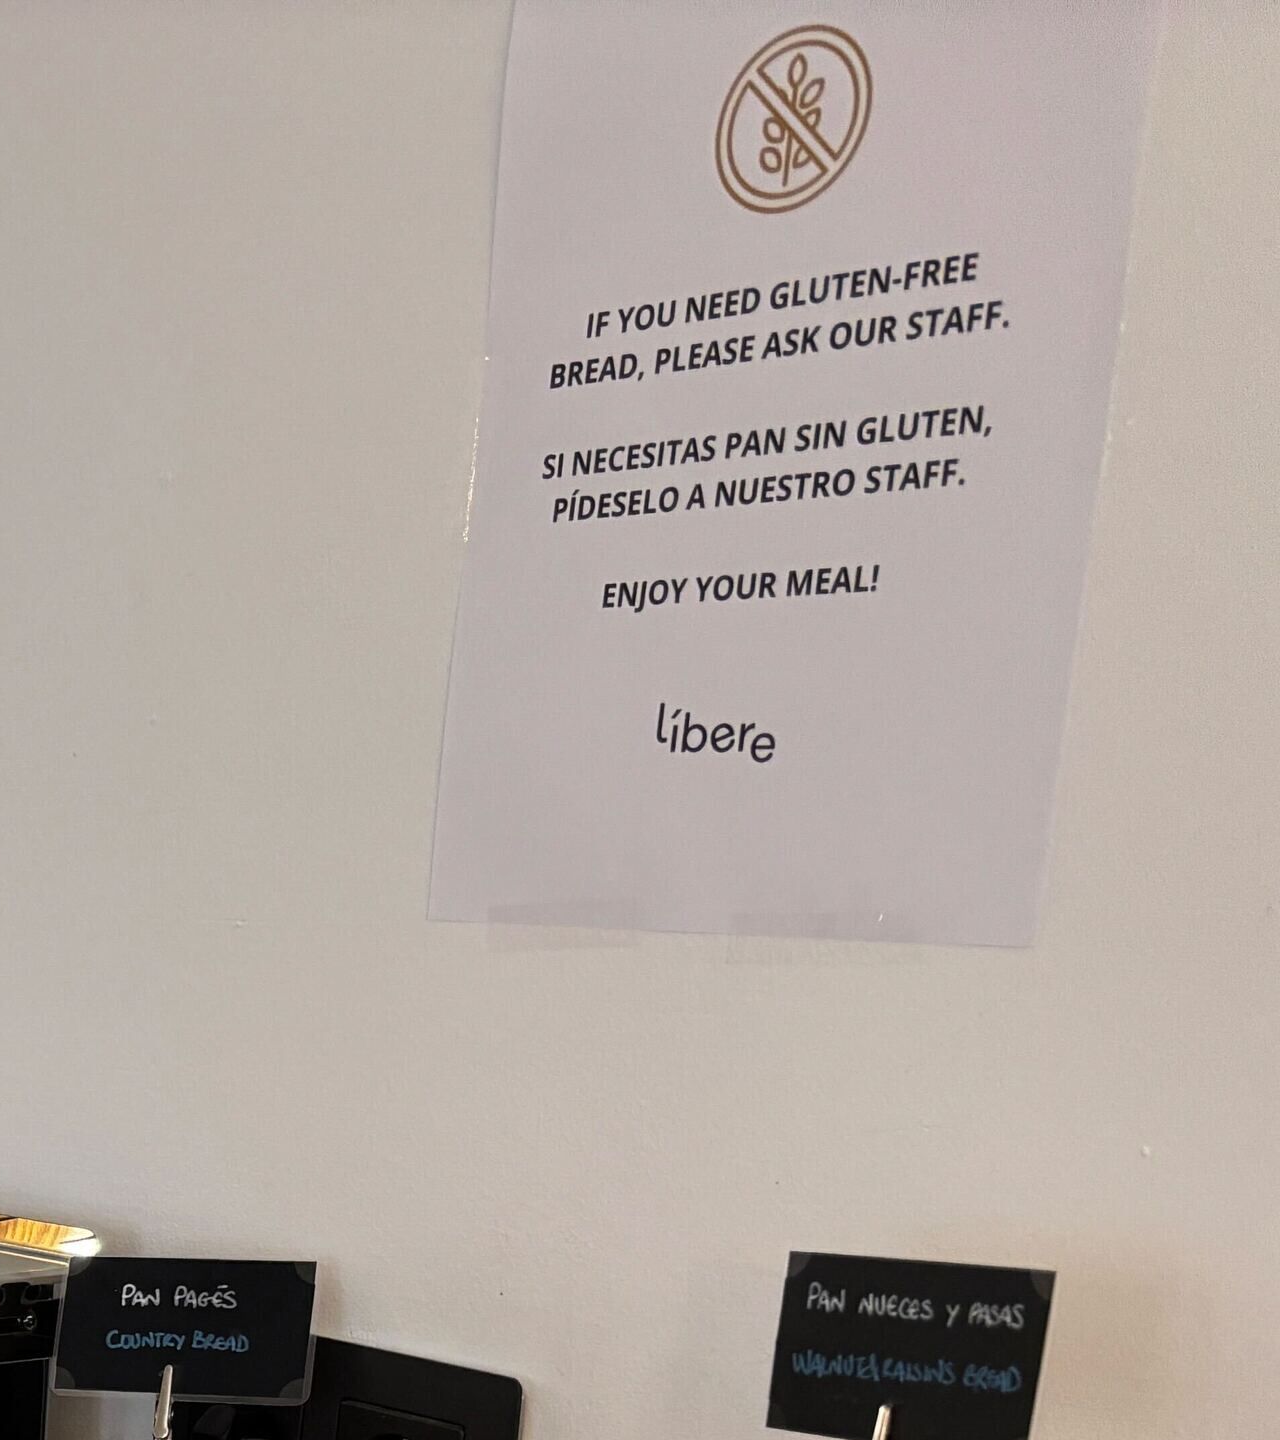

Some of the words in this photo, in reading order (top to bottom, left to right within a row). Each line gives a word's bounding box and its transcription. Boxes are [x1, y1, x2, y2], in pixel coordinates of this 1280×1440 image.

[586, 310, 611, 339] IF
[617, 299, 677, 334] YOU
[684, 287, 762, 324] NEED
[769, 252, 980, 311] GLUTEN-FREE
[549, 352, 645, 390] BREAD,
[654, 334, 756, 375] PLEASE
[760, 324, 822, 360] ASK
[829, 315, 898, 351] OUR
[905, 300, 1010, 341] STAFF.
[541, 452, 565, 480] SI
[571, 434, 717, 477] NECESITAS
[724, 426, 787, 460] PAN
[793, 419, 848, 453] SIN
[856, 404, 992, 446] GLUTEN,
[552, 485, 680, 524] PÍDESELO
[684, 482, 706, 511] A
[714, 468, 856, 508] NUESTRO
[863, 458, 966, 495] STAFF.
[602, 577, 689, 614] ENJOY
[695, 571, 777, 603] YOUR
[785, 564, 881, 597] MEAL!
[656, 702, 776, 764] líbere
